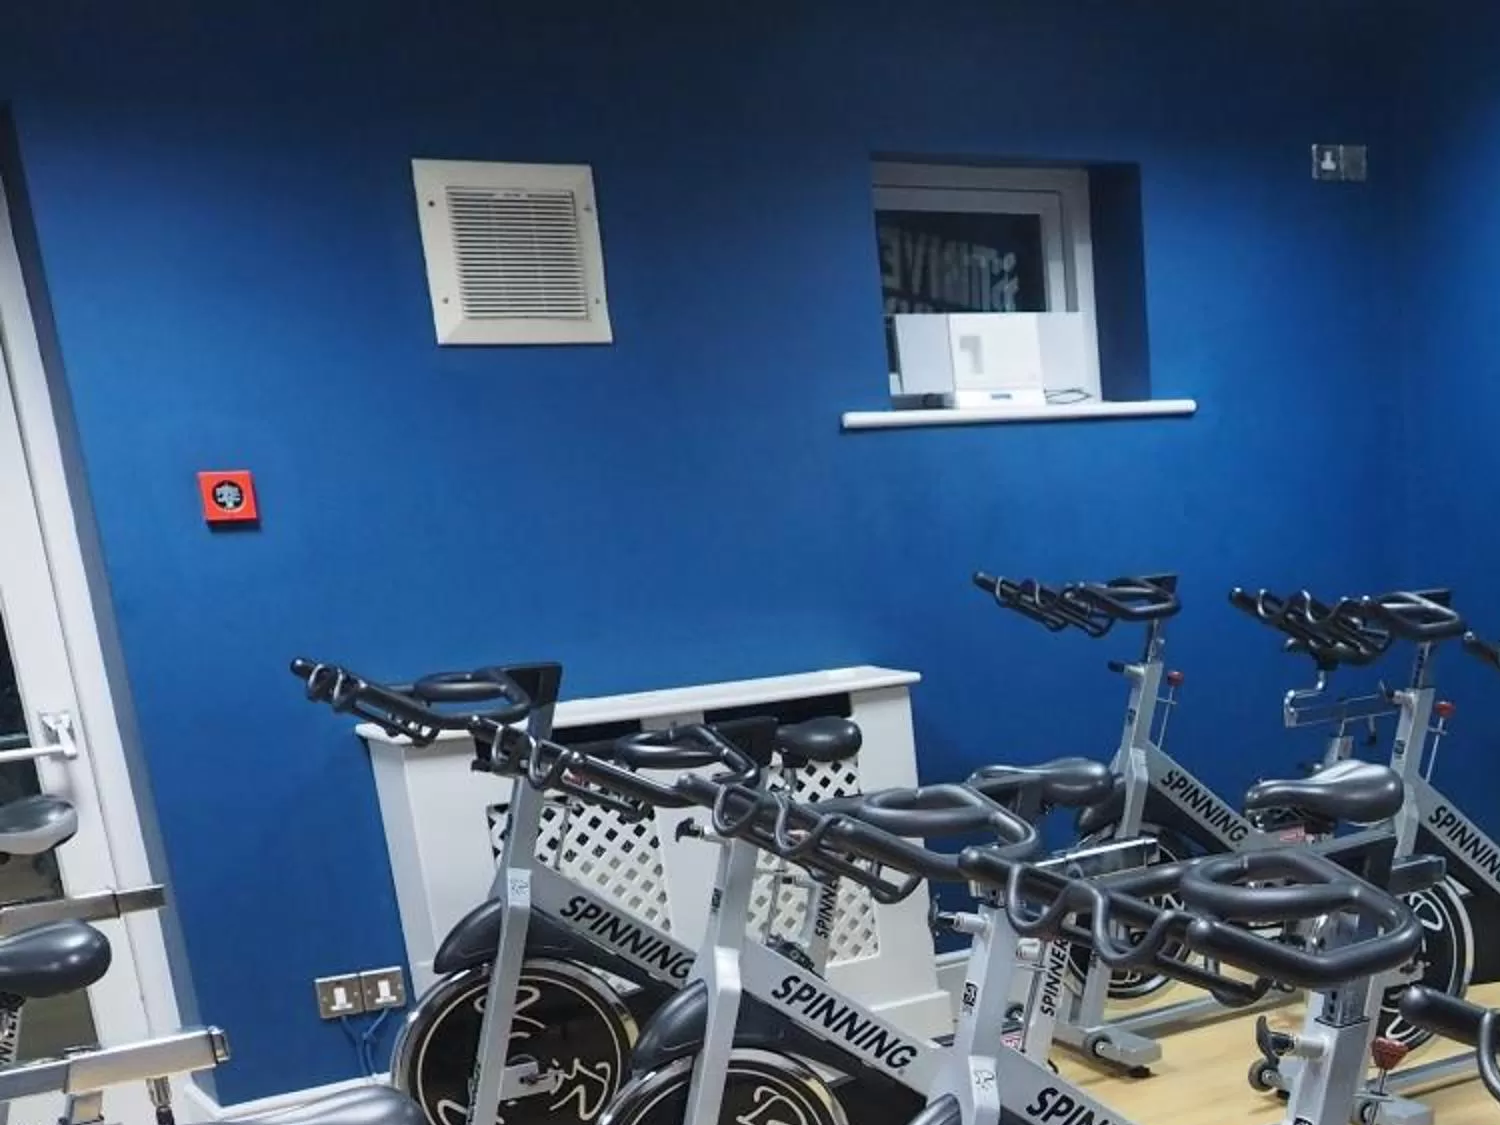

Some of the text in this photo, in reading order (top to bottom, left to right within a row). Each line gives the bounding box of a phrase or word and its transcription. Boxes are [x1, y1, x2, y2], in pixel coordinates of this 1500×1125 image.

[1161, 770, 1248, 842] SPINNING
[559, 895, 695, 979] SPINNING
[1040, 938, 1070, 1017] SPINNER
[772, 974, 918, 1070] SPINNING
